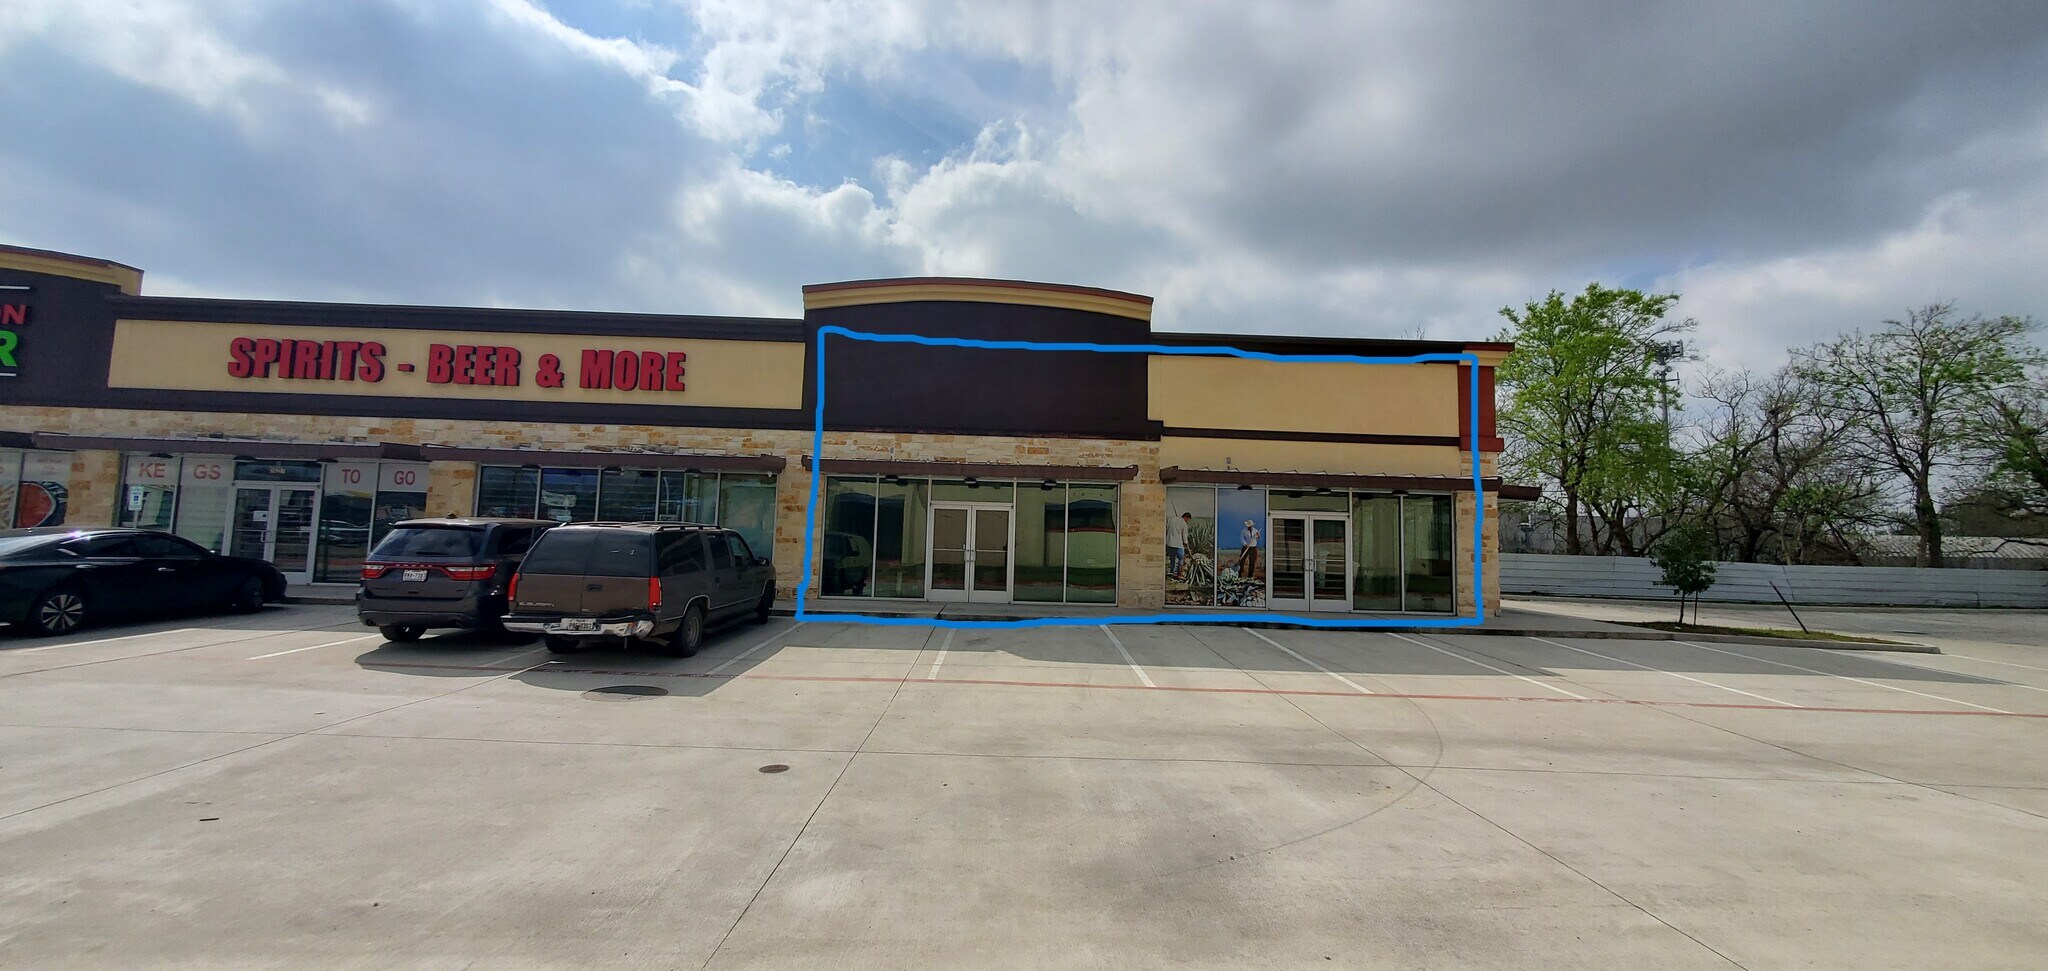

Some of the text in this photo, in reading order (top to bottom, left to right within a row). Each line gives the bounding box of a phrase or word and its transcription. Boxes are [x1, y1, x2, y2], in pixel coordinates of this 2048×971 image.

[0, 303, 27, 325] N
[227, 337, 687, 391] SPIRITS - BEER & MORE
[139, 463, 416, 486] KE GS TO GO
